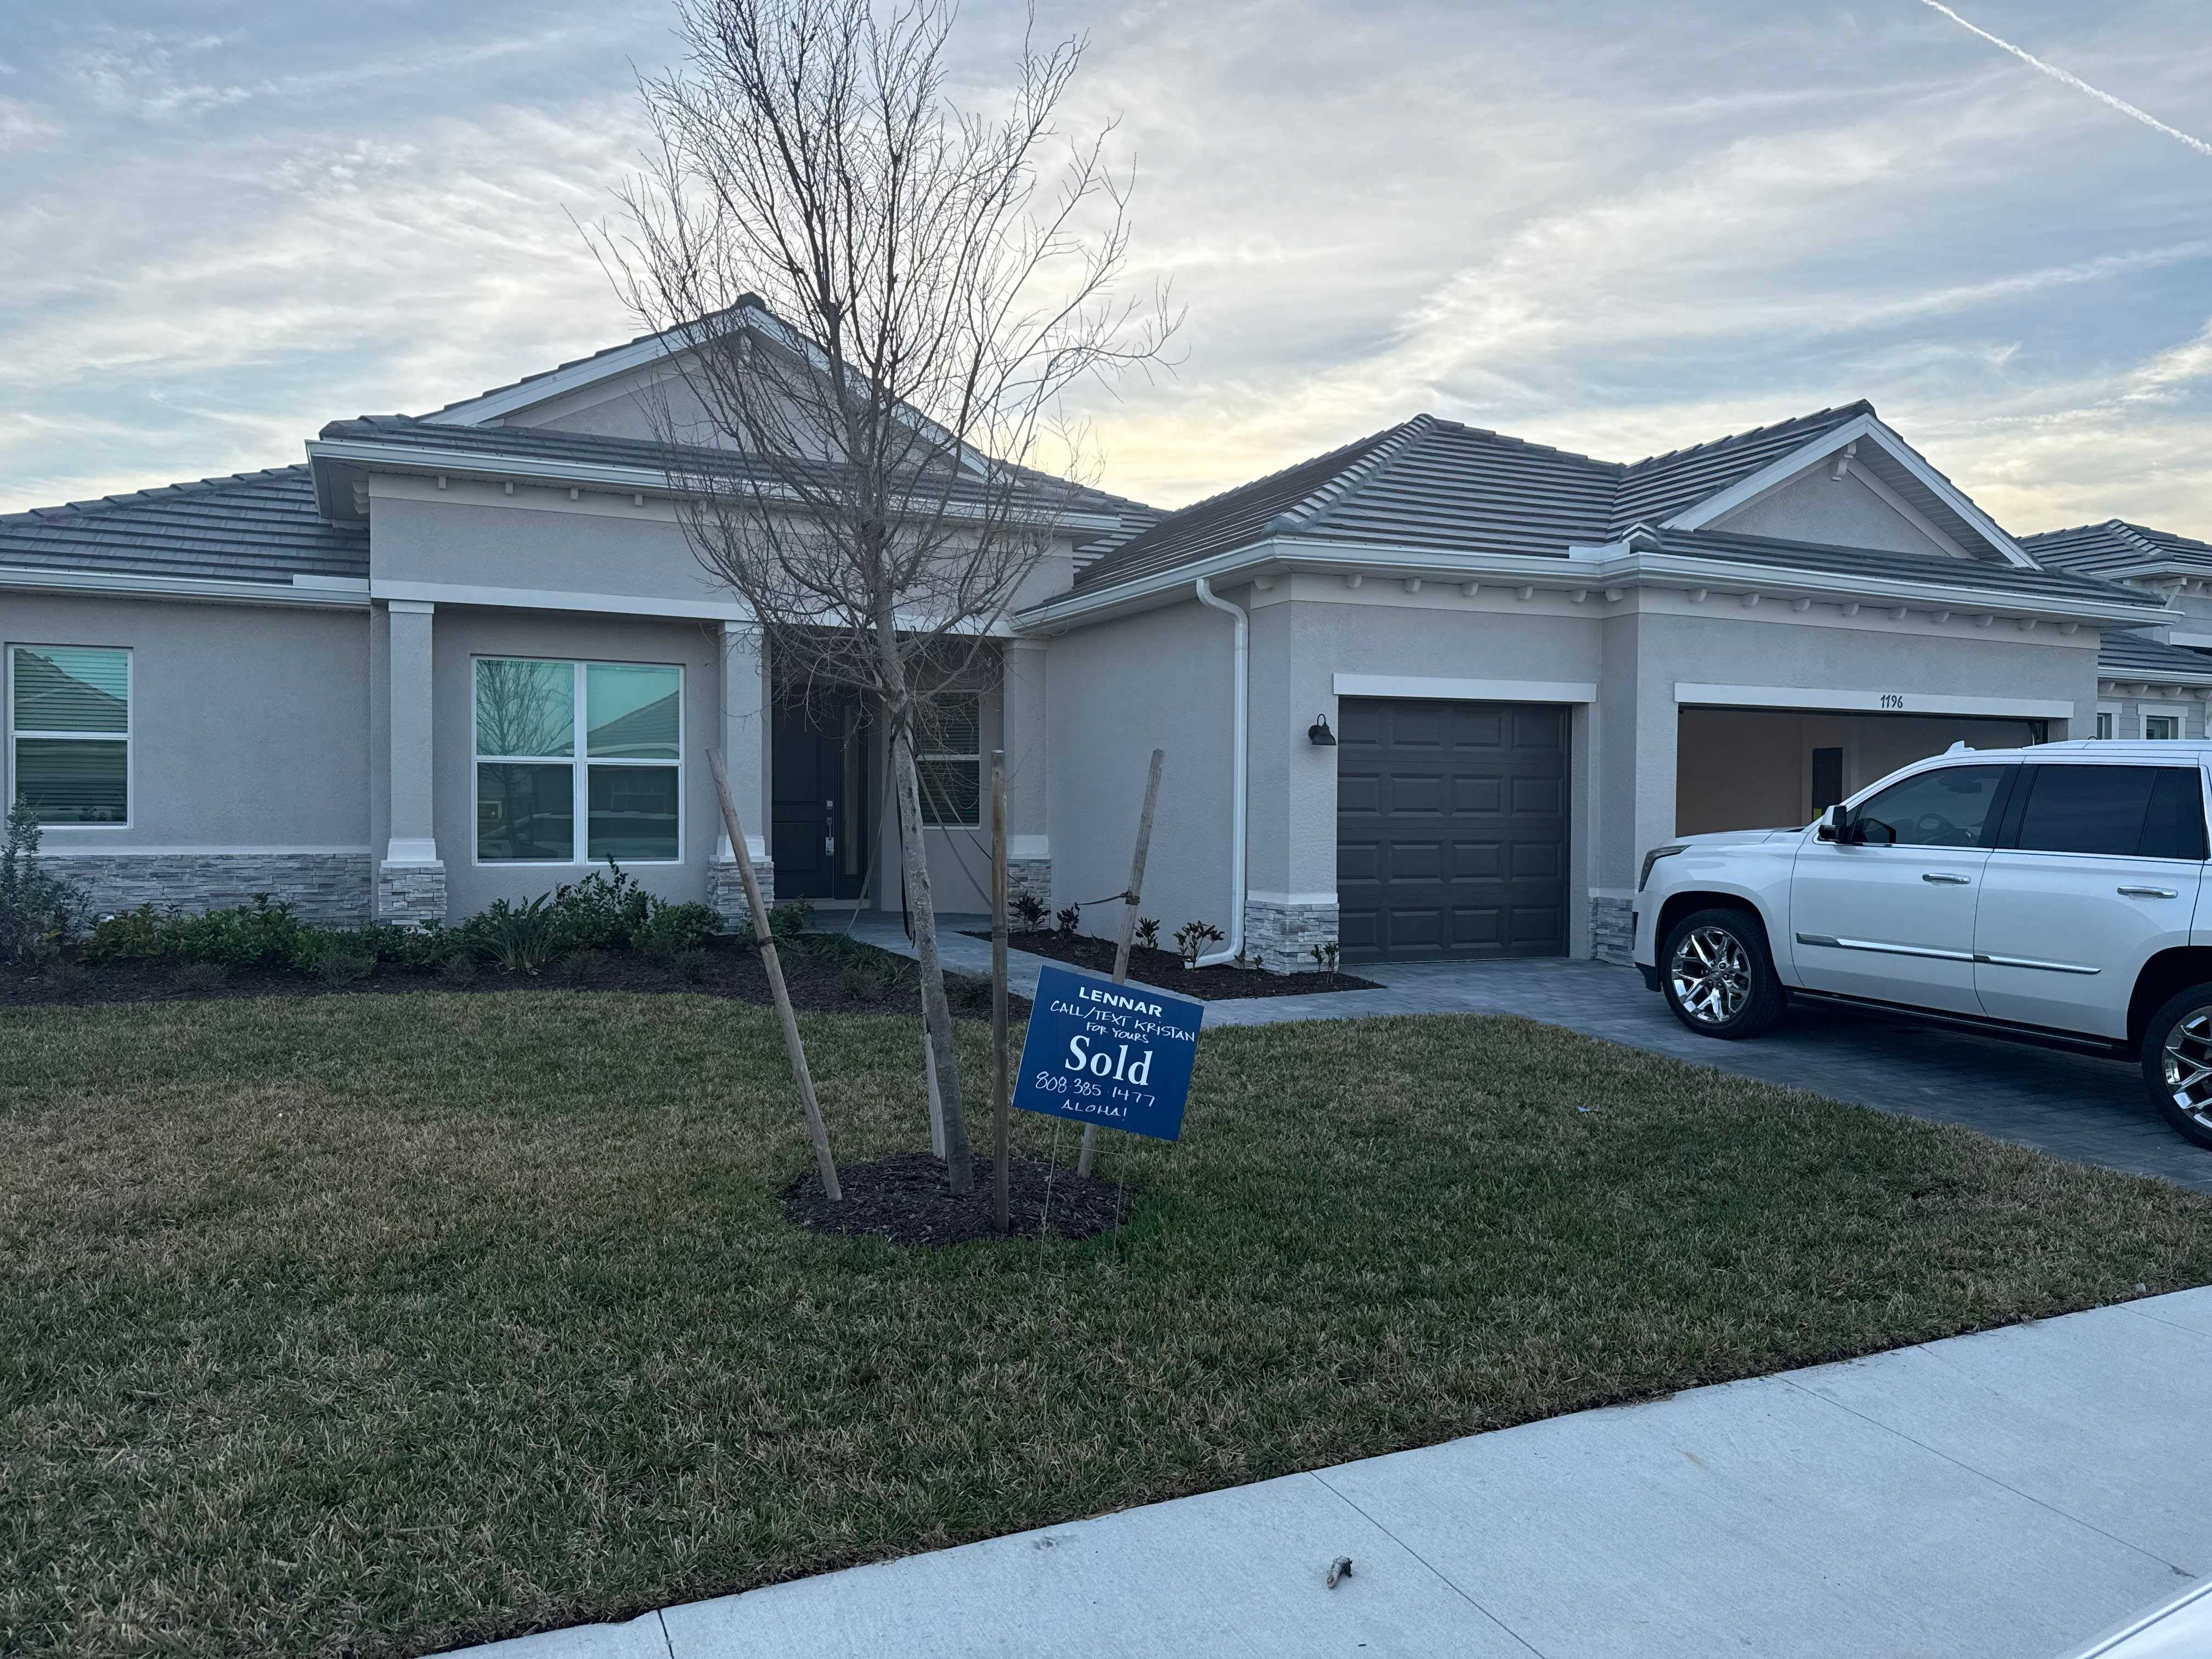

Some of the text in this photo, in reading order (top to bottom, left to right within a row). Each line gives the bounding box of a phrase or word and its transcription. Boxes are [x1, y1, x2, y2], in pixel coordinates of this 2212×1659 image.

[1881, 694, 1903, 709] 1196
[1050, 1000, 1132, 1026] CALL/TEXT
[1079, 986, 1162, 1017] LENNAR
[1086, 1022, 1108, 1035] FOR
[1065, 1035, 1153, 1086] Sold
[1061, 1099, 1127, 1121] ALOHA!
